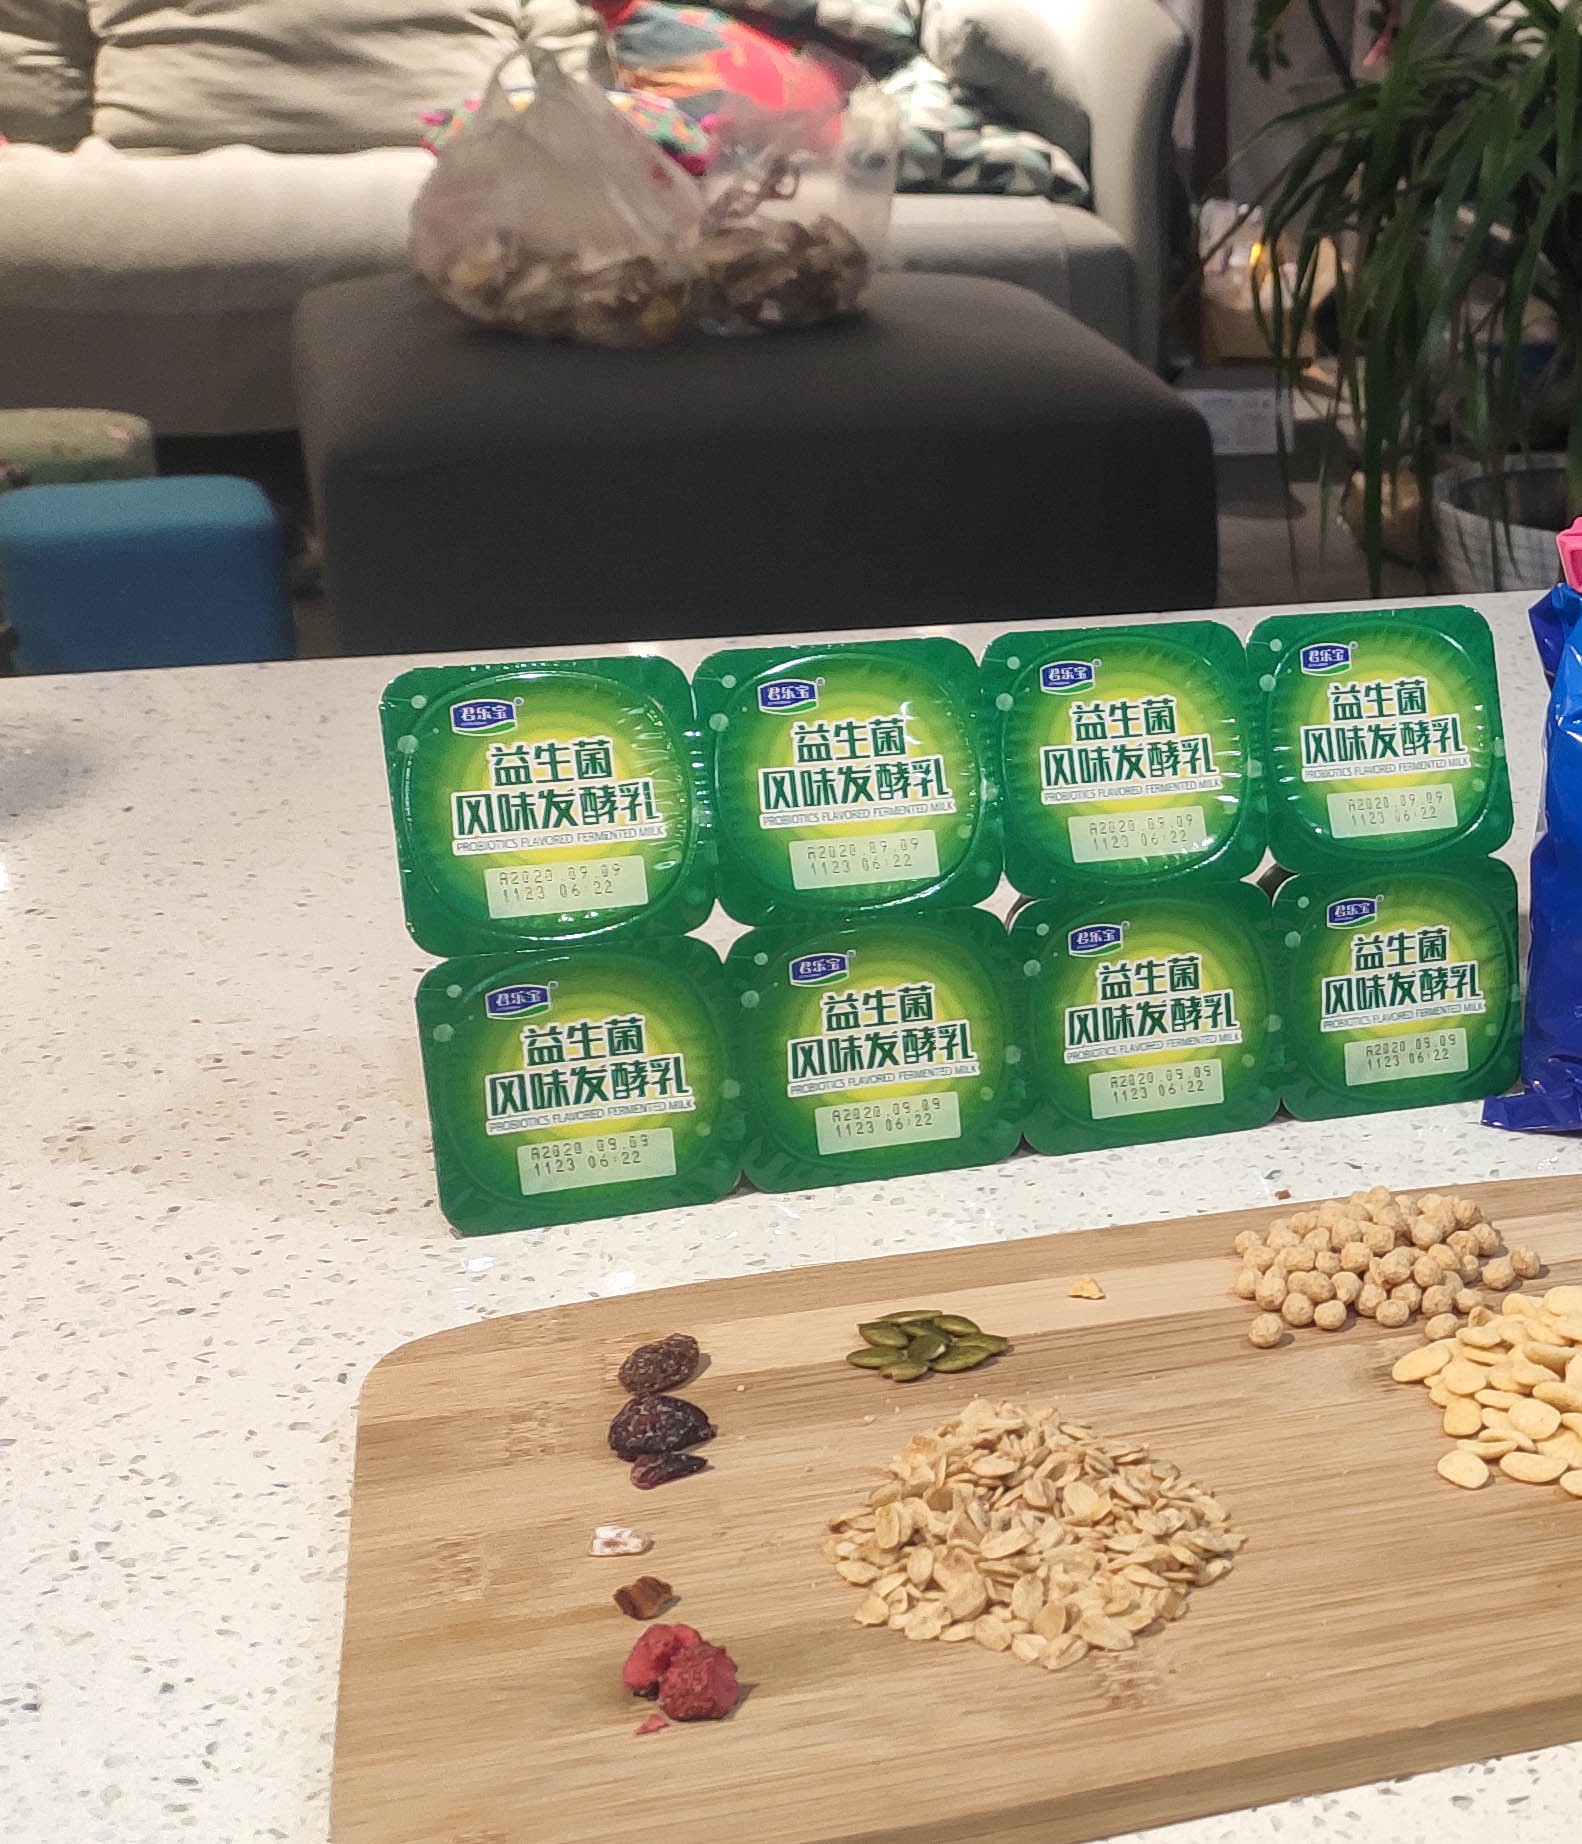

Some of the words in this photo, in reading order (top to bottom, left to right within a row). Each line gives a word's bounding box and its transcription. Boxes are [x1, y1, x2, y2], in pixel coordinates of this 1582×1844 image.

[767, 686, 810, 701] 君乐宝
[1330, 679, 1428, 721] 益生菌
[1072, 698, 1176, 742] 益生菌
[795, 718, 906, 763] 益生菌
[1303, 717, 1465, 765] 风味发酵乳
[491, 740, 613, 786] 益生菌
[1043, 737, 1216, 786] 风味发酵乳
[1304, 766, 1352, 779] PROBIOTICS
[1354, 764, 1395, 776] FLAVORED
[1398, 759, 1446, 771] FERMENTED
[1448, 758, 1470, 768] MILK
[762, 758, 949, 810] 风味发酵乳
[1044, 790, 1096, 802] PROBIOTICS
[1098, 787, 1143, 798] FLAVORED
[1145, 782, 1197, 795] FERMENTED
[1199, 780, 1221, 790] MILK
[455, 781, 660, 836] 风味发酵乳
[763, 813, 819, 826] PROBIOTICS
[822, 809, 870, 821] FLAVORED
[873, 804, 928, 817] FERMENTED
[930, 802, 954, 811] MILK
[1351, 810, 1385, 826] 1123
[457, 838, 518, 851] PROBIOTICS
[521, 834, 574, 848] FLAVORED
[577, 829, 637, 844] FERMENTED
[639, 827, 665, 837] MILK
[1093, 835, 1129, 850] 1123
[810, 860, 850, 876] 1123
[503, 885, 545, 903] 1123
[1354, 928, 1448, 971] 益生菌
[1100, 956, 1200, 1001] 益生菌
[1325, 963, 1482, 1016] 风味发酵乳
[823, 984, 934, 1032] 益生菌
[1068, 992, 1237, 1046] 风味发酵乳
[1323, 1016, 1371, 1030] PROBIOTICS
[1373, 1011, 1413, 1024] FLAVORED
[1416, 1005, 1461, 1018] FERMENTED
[1463, 1002, 1484, 1012] MILK
[524, 1016, 644, 1066] 益生菌
[791, 1023, 974, 1080] 风味发酵乳
[1067, 1047, 1117, 1062] PROBIOTICS
[1119, 1041, 1164, 1055] FLAVORED
[1167, 1035, 1218, 1048] FERMENTED
[1219, 1032, 1240, 1042] MILK
[790, 1079, 846, 1095] PROBIOTICS
[847, 1072, 896, 1087] FLAVORED
[898, 1066, 953, 1080] FERMENTED
[954, 1064, 978, 1074] MILK
[1368, 1056, 1400, 1071] 1123
[489, 1056, 690, 1116] 风味发酵乳
[1113, 1087, 1148, 1104] 1123
[489, 1116, 549, 1132] PROBIOTICS
[552, 1109, 604, 1124] FLAVORED
[607, 1101, 666, 1116] FERMENTED
[668, 1099, 694, 1110] MILK
[835, 1121, 875, 1137] 1123
[534, 1158, 576, 1176] 1123
